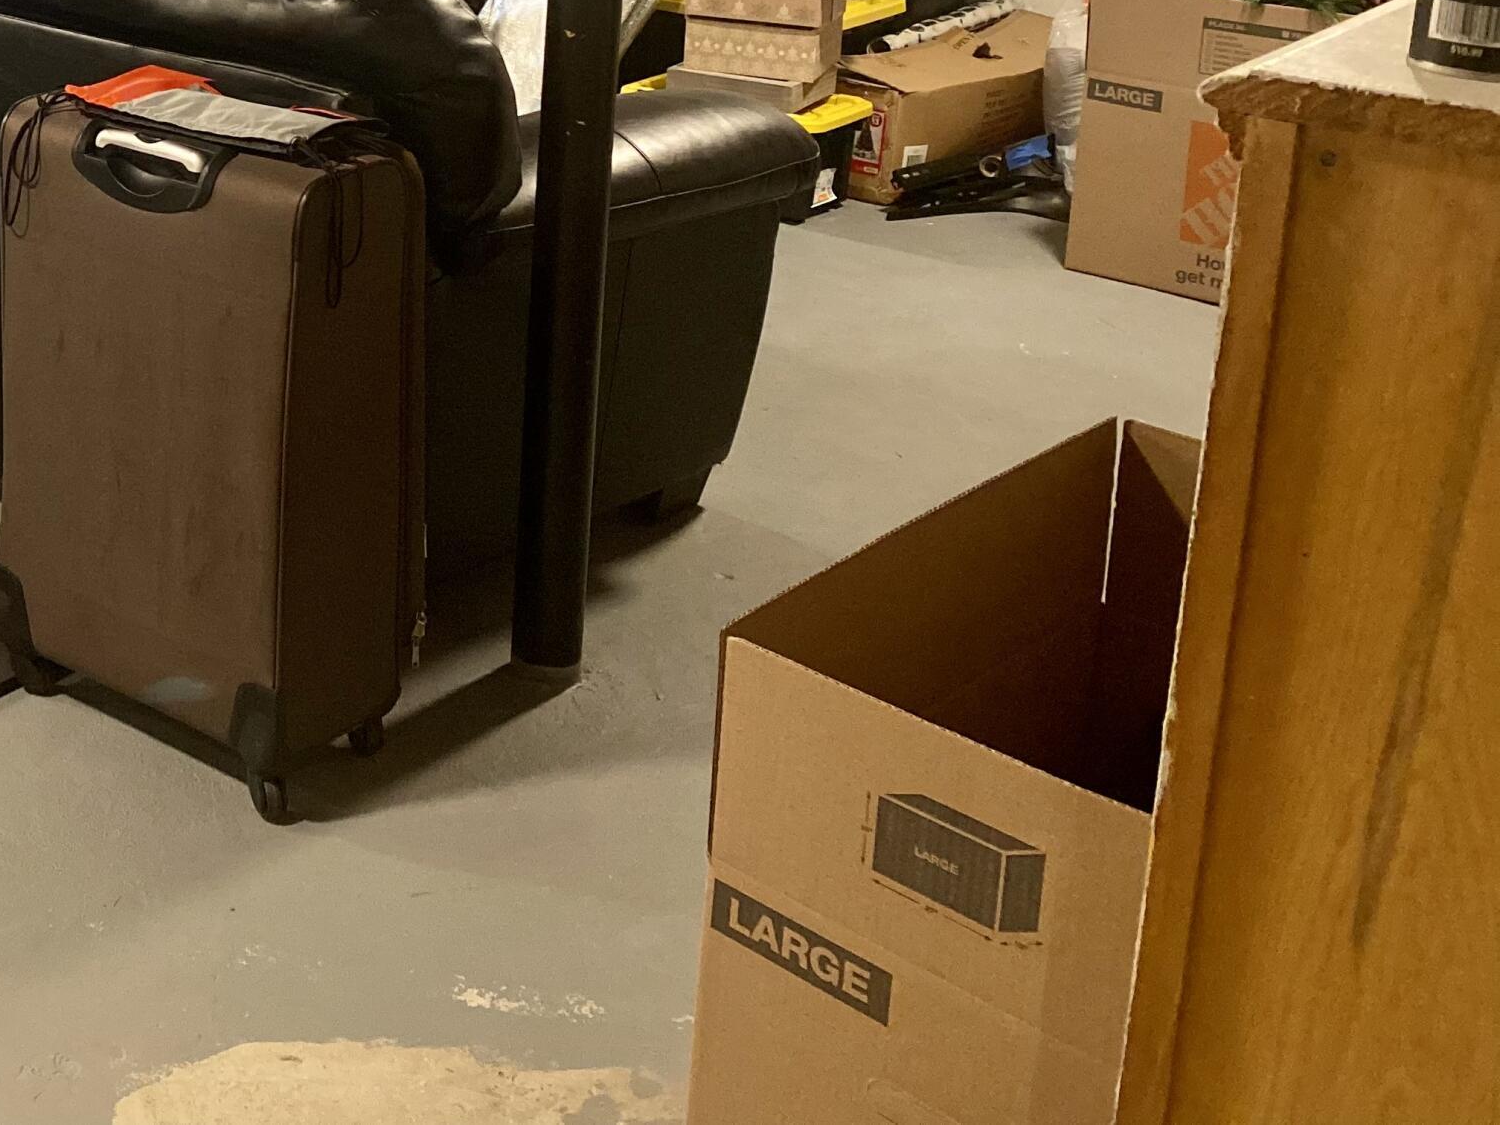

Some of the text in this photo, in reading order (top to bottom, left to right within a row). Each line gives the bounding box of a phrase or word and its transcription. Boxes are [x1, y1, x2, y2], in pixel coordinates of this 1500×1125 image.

[1093, 82, 1157, 107] LARGE
[1175, 269, 1205, 284] get
[914, 845, 959, 876] LARGE
[728, 897, 871, 1004] LARGE
